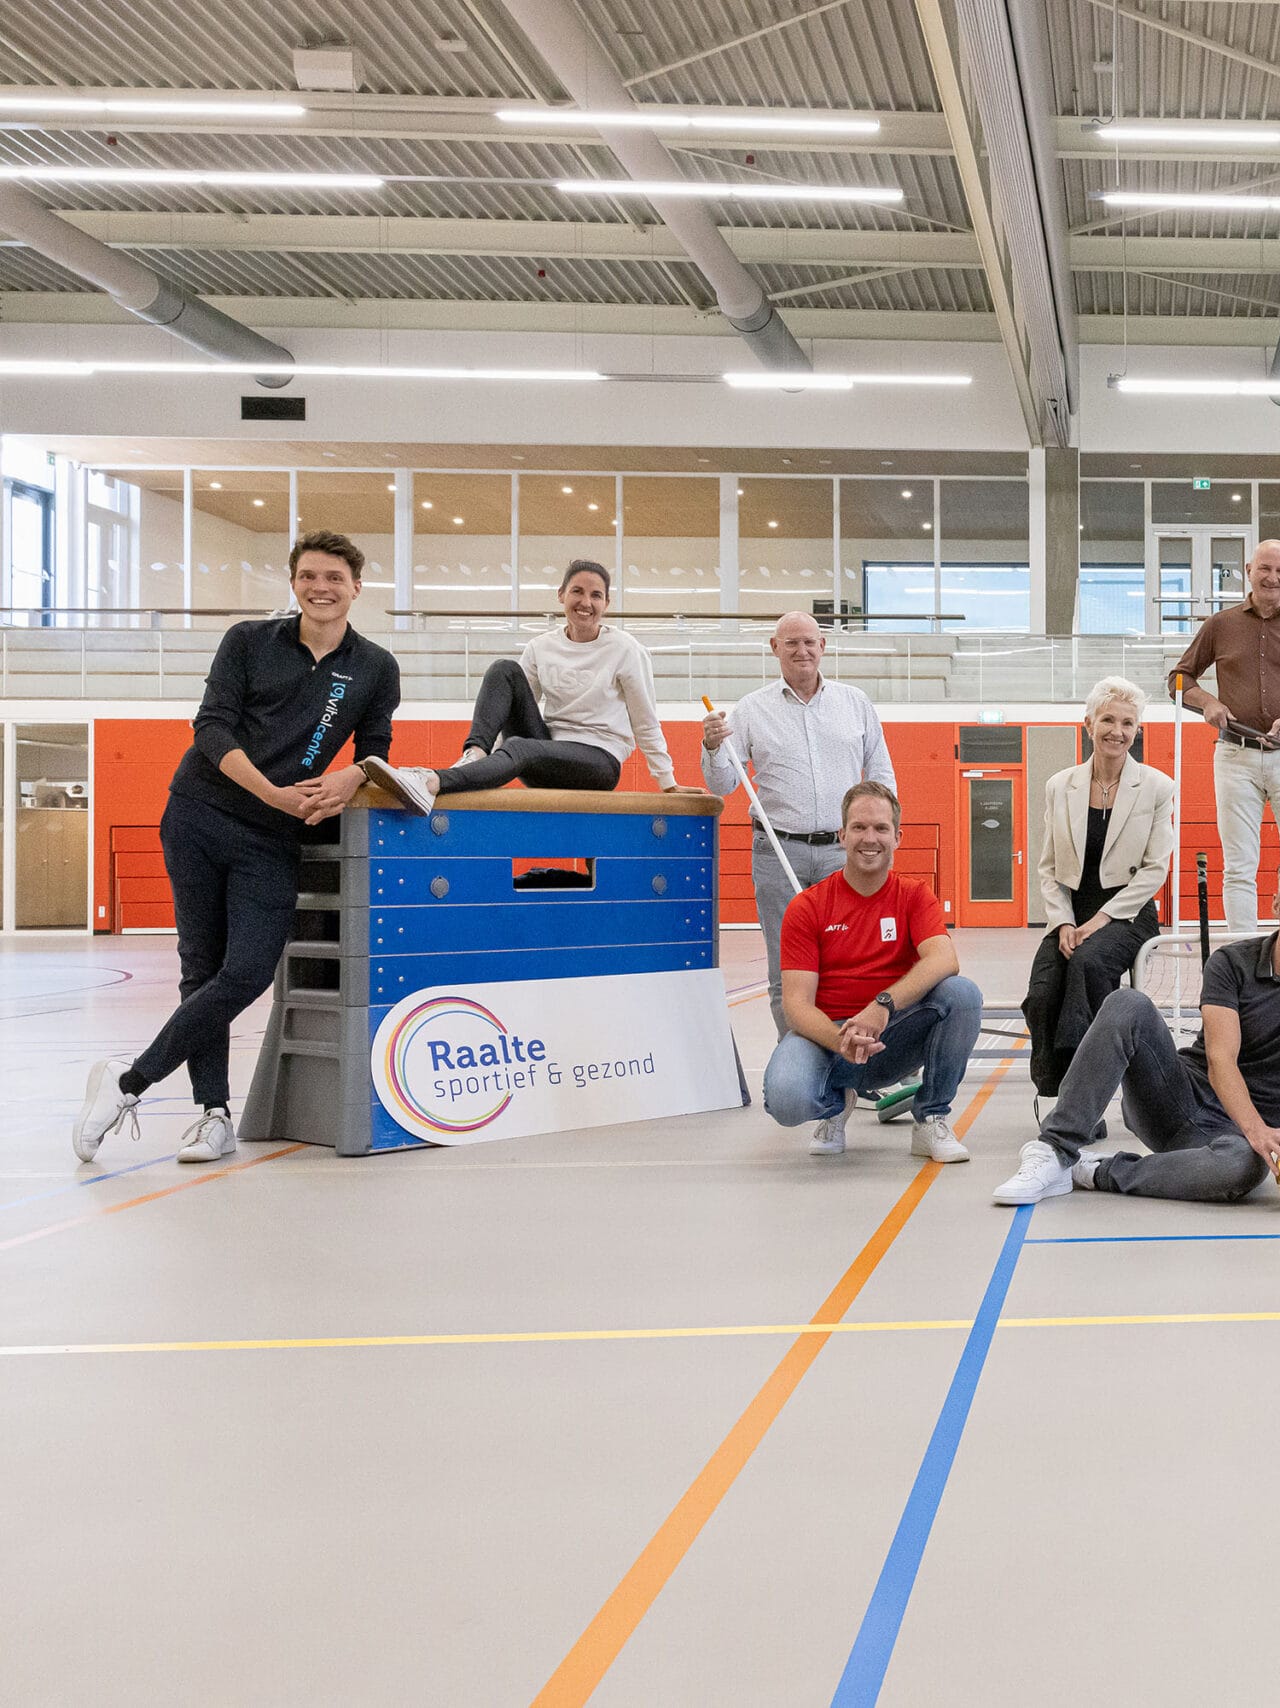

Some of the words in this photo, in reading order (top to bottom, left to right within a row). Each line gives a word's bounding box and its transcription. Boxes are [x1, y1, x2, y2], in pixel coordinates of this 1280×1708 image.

[427, 1034, 547, 1072] Raalte
[433, 1063, 537, 1102] sportief
[547, 1062, 563, 1085] &
[572, 1051, 656, 1088] gezond
